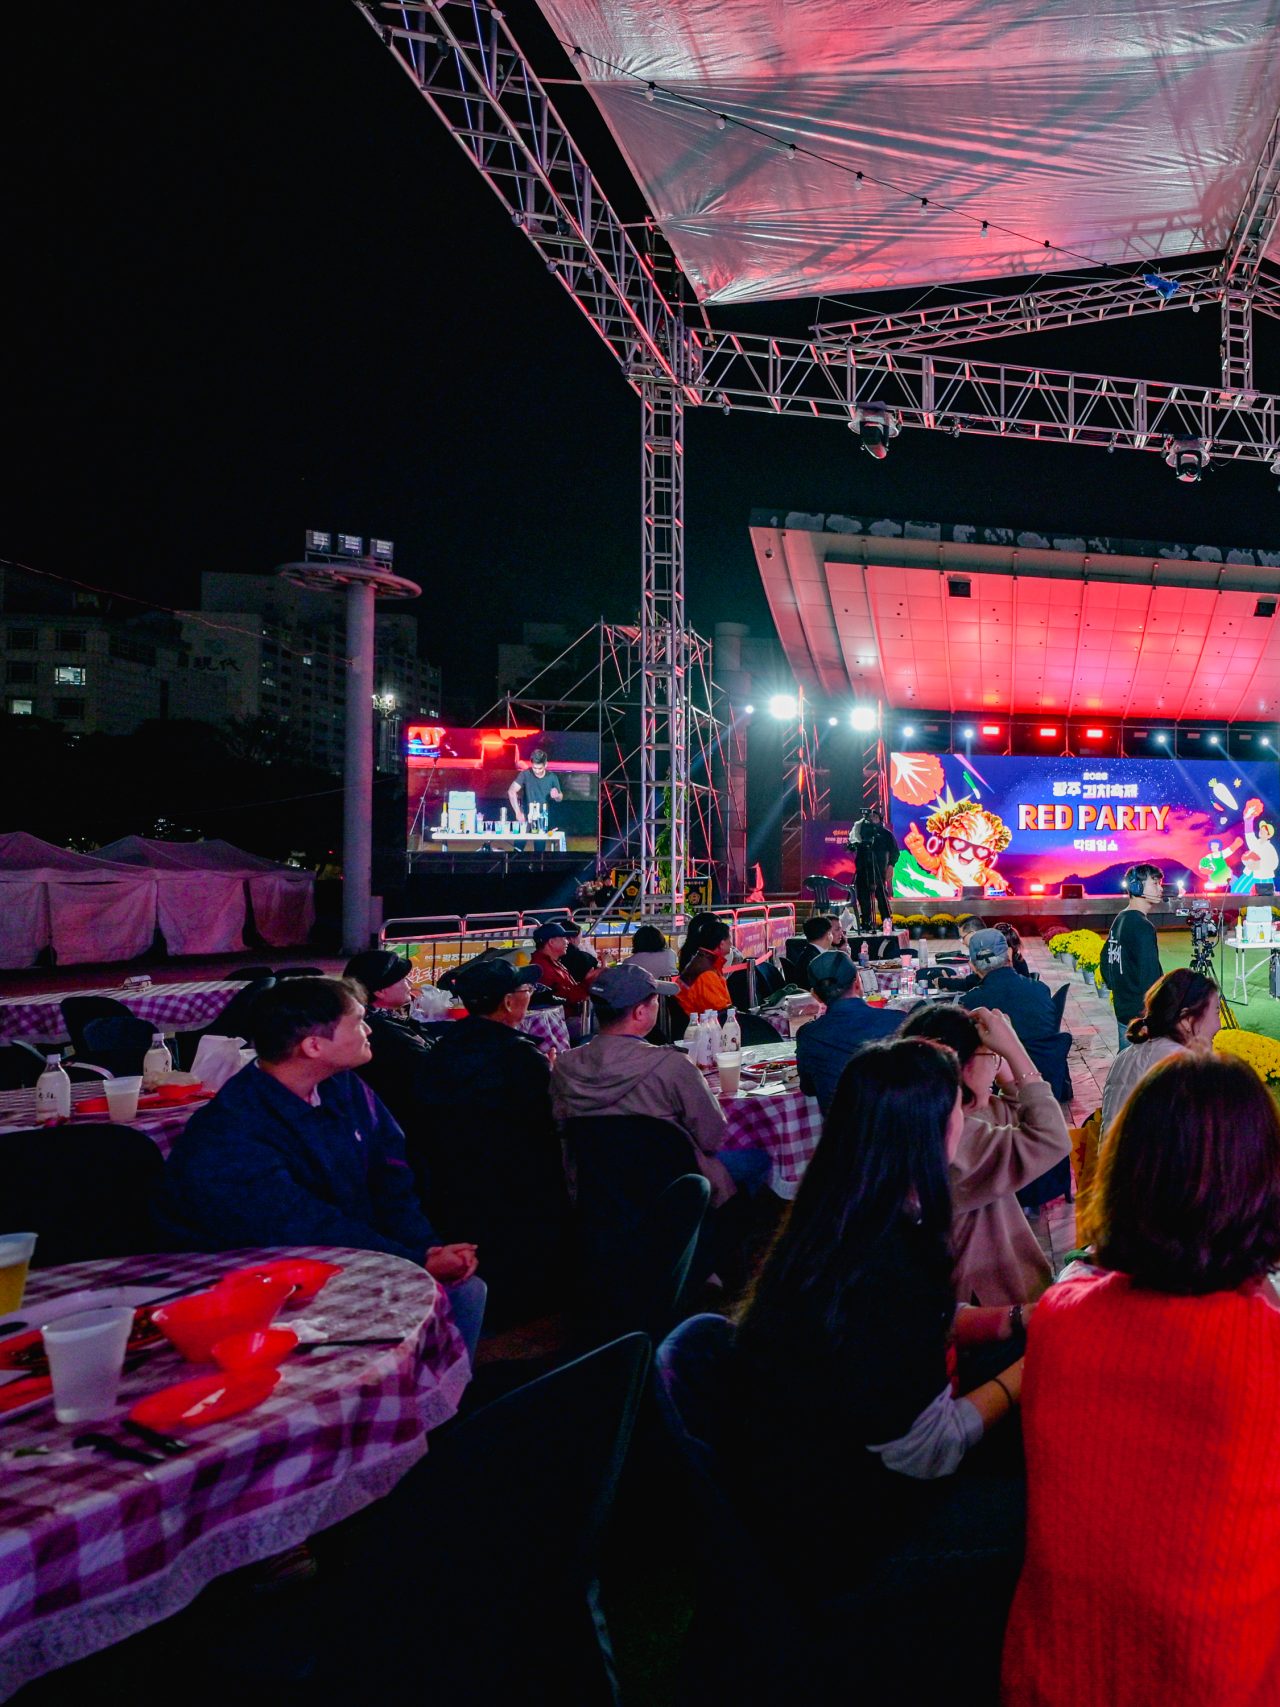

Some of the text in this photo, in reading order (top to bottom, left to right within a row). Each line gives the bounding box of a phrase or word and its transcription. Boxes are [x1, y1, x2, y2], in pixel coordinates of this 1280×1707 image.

[1053, 781, 1139, 799] 광주 김치축제
[1018, 804, 1170, 831] RED PARTY
